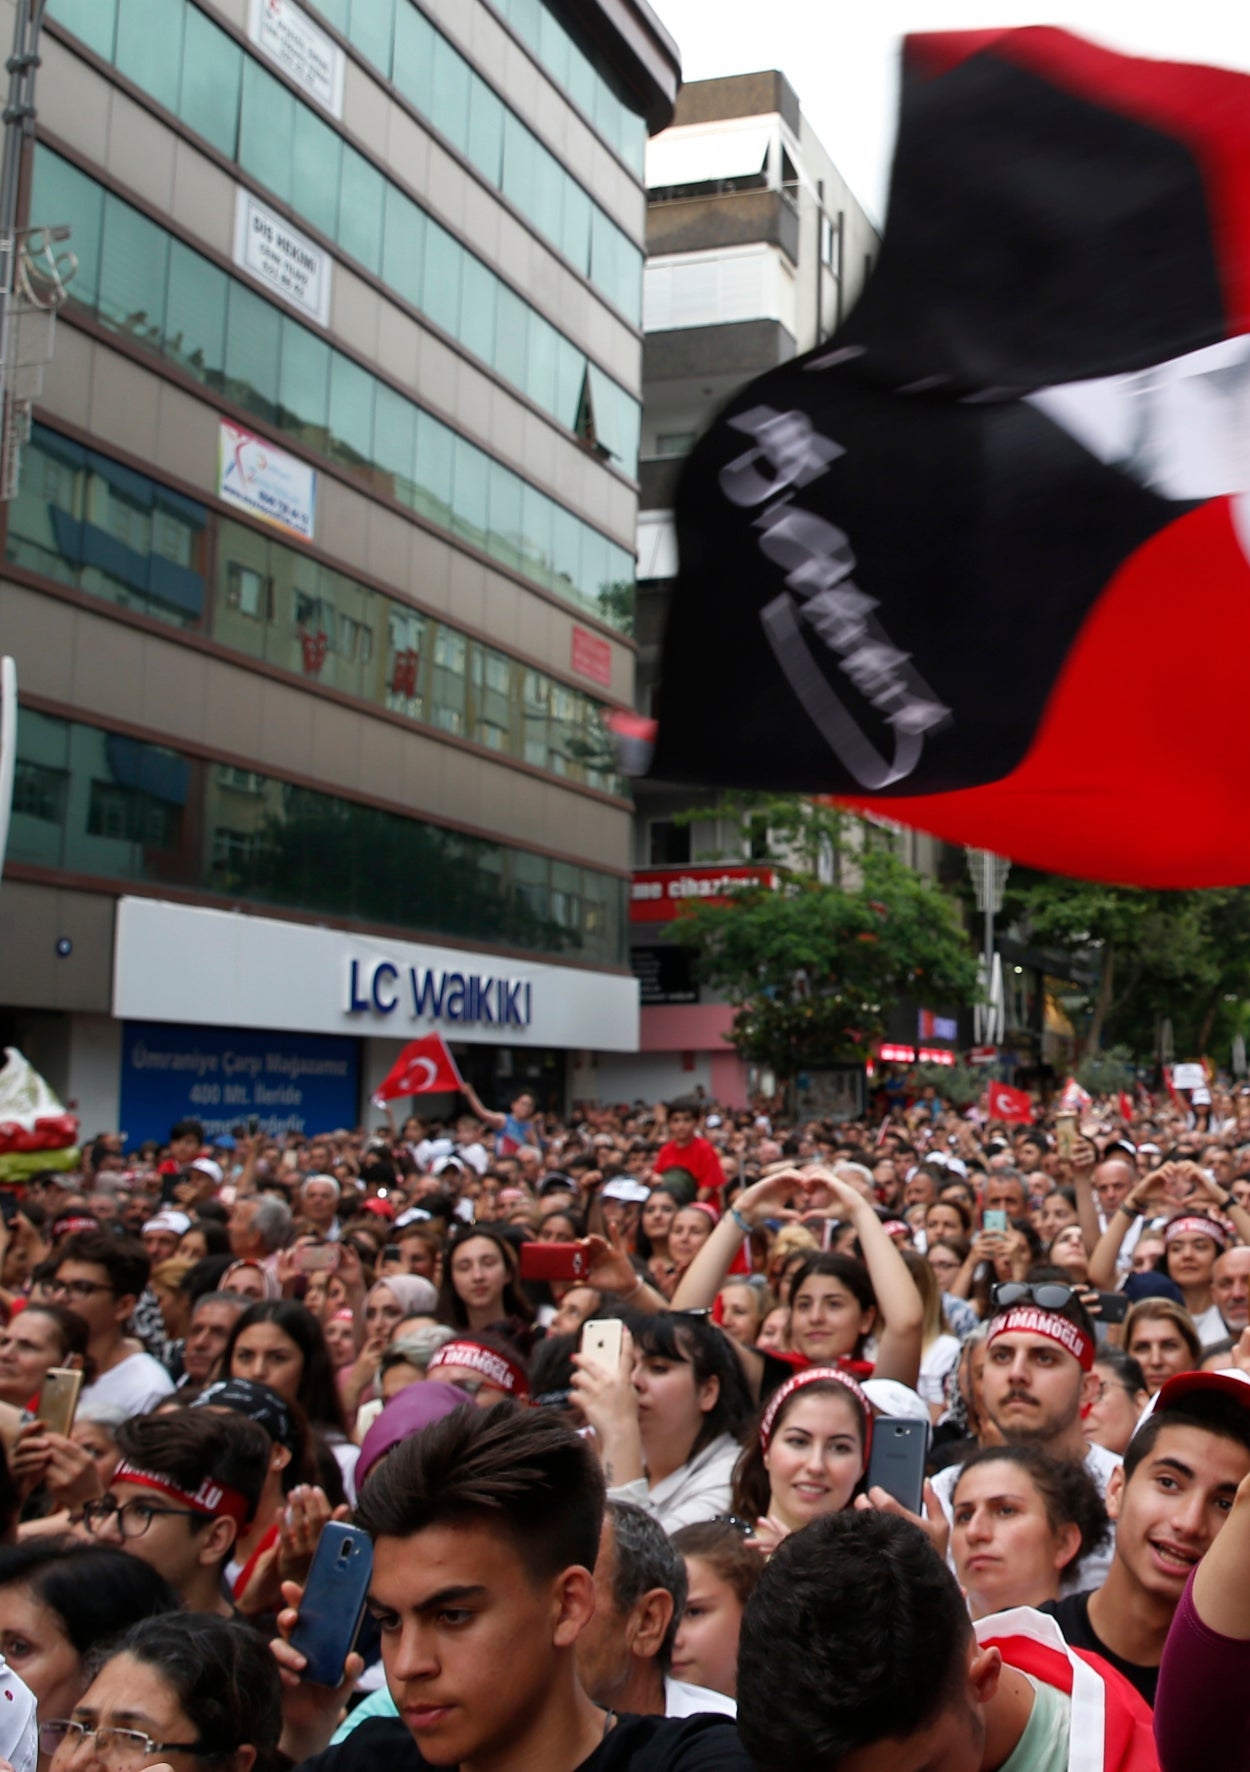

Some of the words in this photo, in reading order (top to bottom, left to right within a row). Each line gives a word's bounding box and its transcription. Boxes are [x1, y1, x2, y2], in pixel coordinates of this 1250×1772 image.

[349, 958, 400, 1014] LC
[131, 1040, 217, 1075] Ümraniye
[189, 1083, 221, 1105] 400
